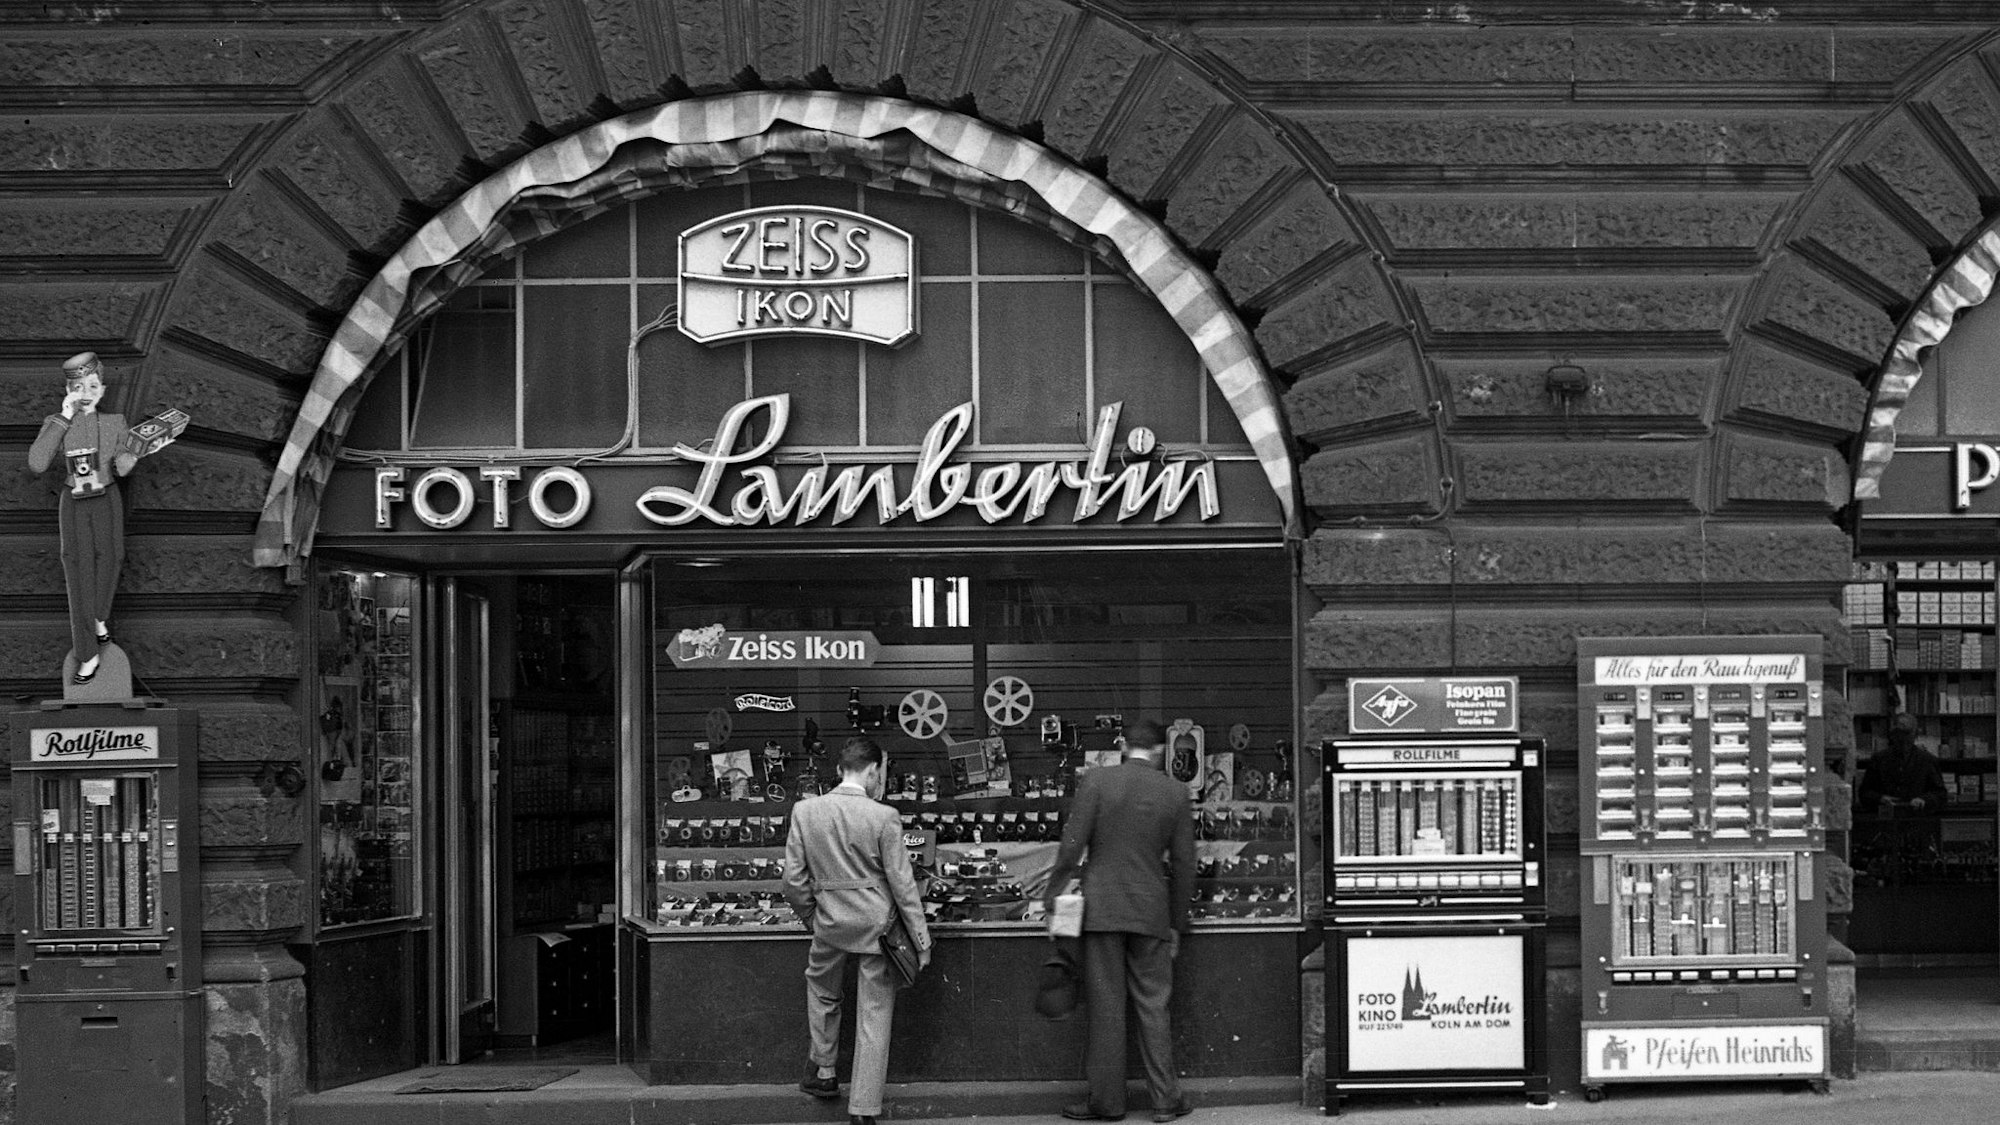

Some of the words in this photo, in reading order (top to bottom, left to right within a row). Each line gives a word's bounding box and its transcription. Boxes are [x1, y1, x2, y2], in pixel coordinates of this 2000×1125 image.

[721, 217, 871, 275] ZEISS
[737, 289, 852, 328] IKON
[375, 466, 591, 529] FOTO
[636, 393, 1221, 526] Lambertin
[728, 634, 797, 661] Zeiss
[805, 636, 865, 660] Ikon
[1605, 658, 1642, 680] Alles
[1645, 658, 1669, 682] für
[1670, 658, 1698, 678] den
[1703, 655, 1800, 681] Rauchgenuß
[1445, 683, 1506, 701] Isopan
[1368, 694, 1410, 719] Agfa
[39, 729, 152, 759] Rollfilme
[1393, 750, 1460, 760] ROLLFILME
[1358, 993, 1396, 1005] FOTO
[1412, 992, 1511, 1017] Lambertin
[1358, 1010, 1396, 1022] KINO
[1465, 1020, 1482, 1028] AM
[1486, 1019, 1511, 1028] DOM
[1646, 1036, 1720, 1070] Pfeifen
[1726, 1035, 1813, 1064] Heinrichs
